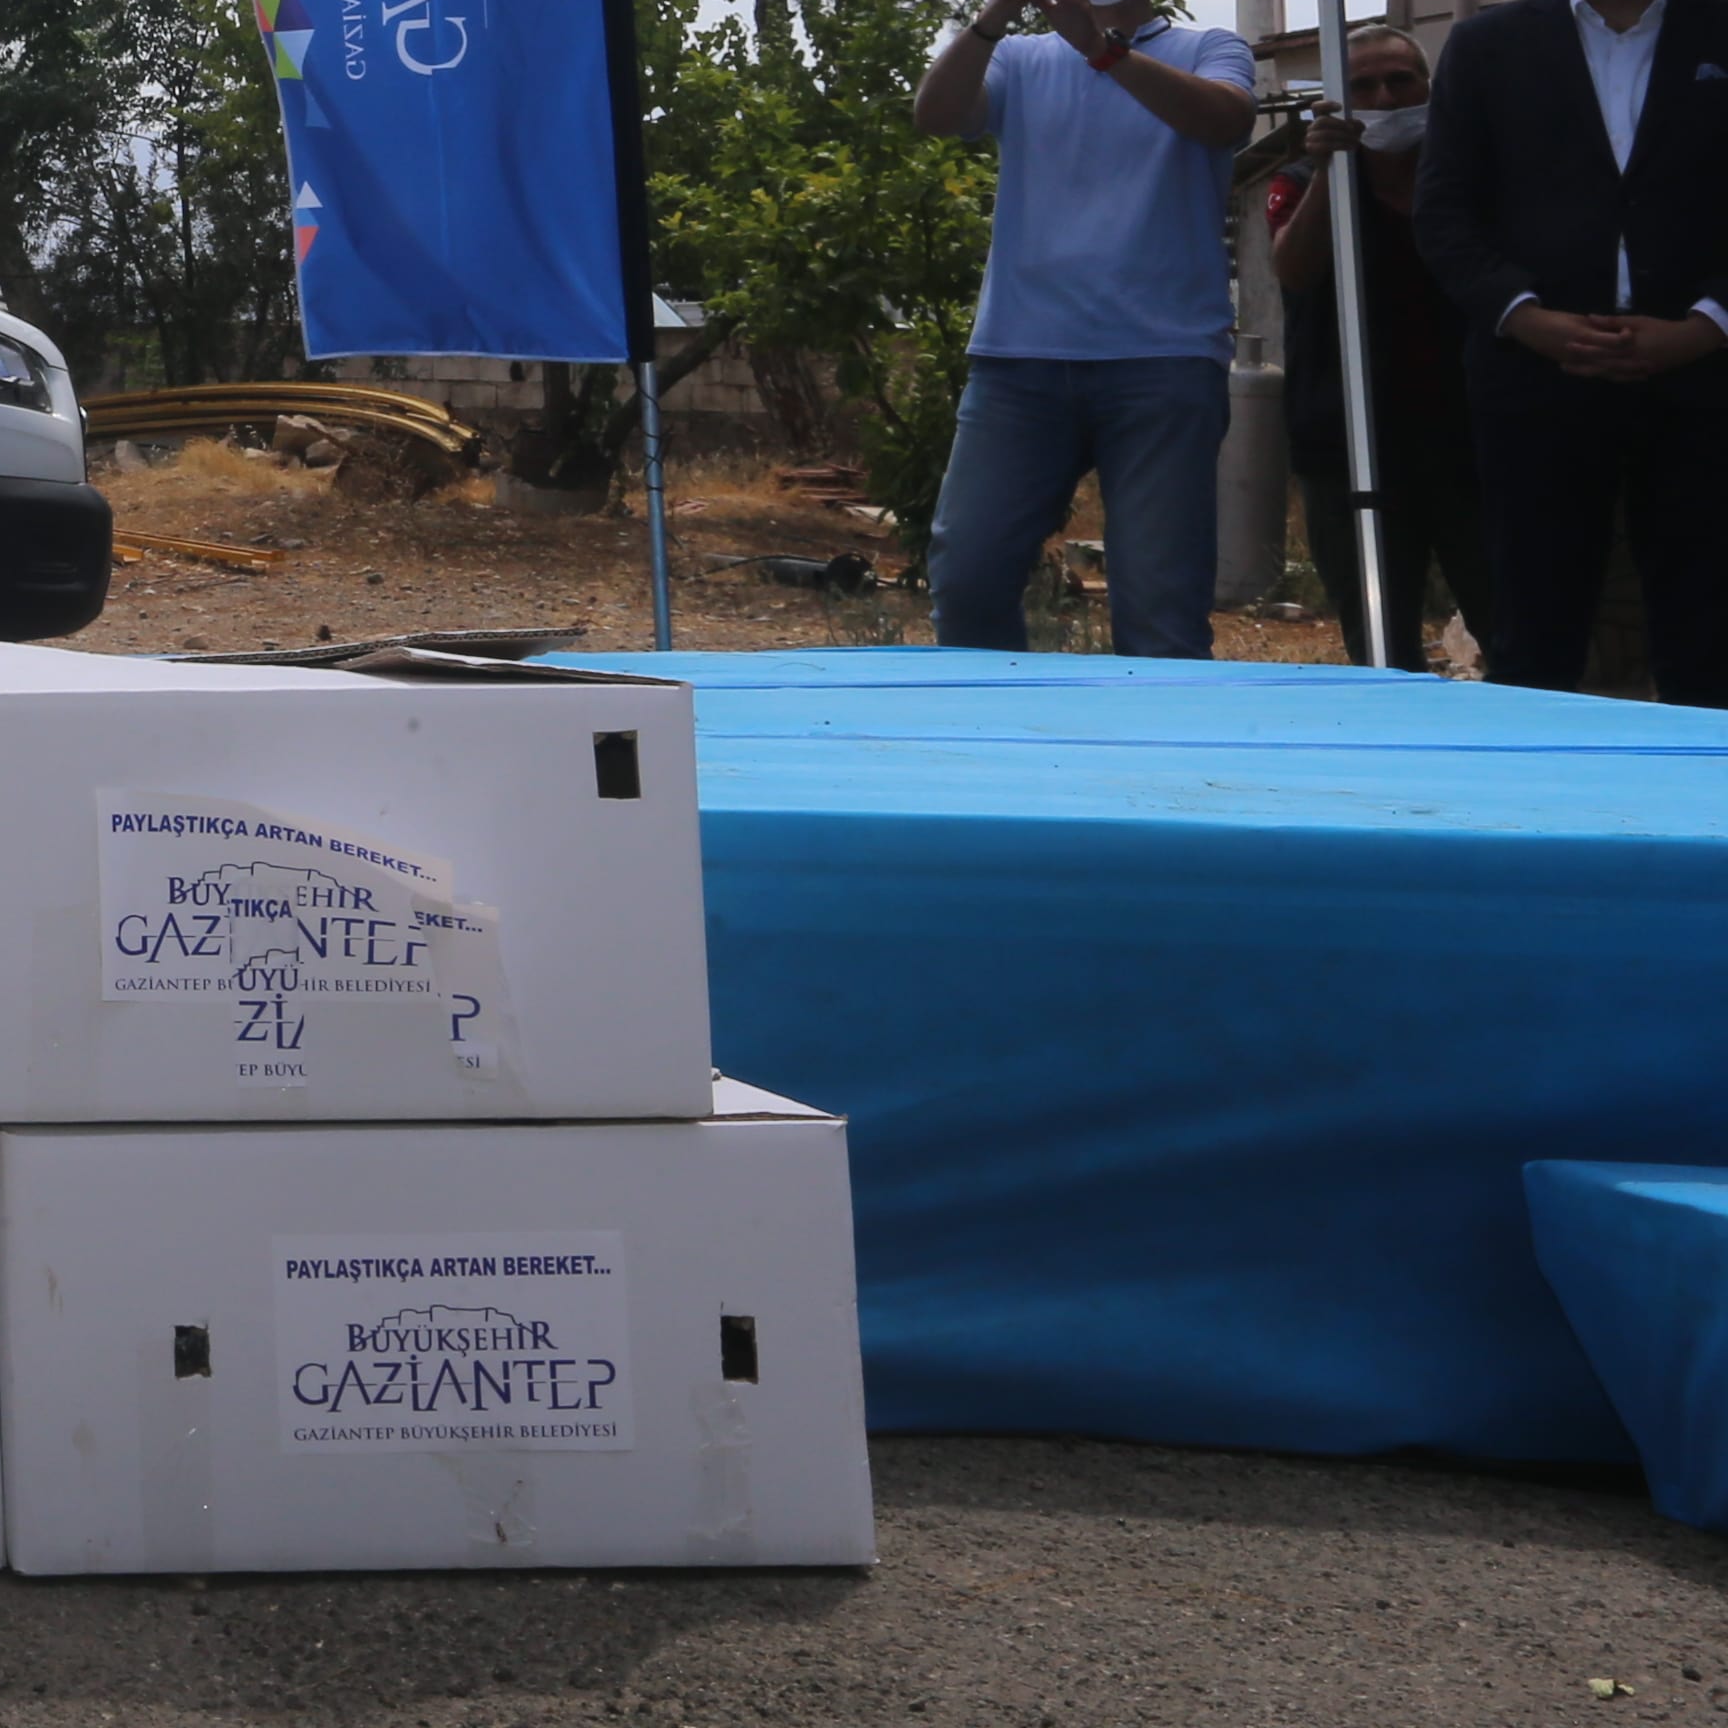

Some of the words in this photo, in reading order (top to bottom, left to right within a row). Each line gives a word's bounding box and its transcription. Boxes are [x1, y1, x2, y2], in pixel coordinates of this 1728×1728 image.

[111, 813, 248, 839] PAYLAŞTIKÇA
[255, 822, 323, 848] ARTAN
[329, 839, 437, 882] BEREKET...
[115, 976, 212, 992] GAZİANTEP
[334, 977, 432, 994] BELEDİYESİ
[286, 1258, 424, 1284] PAYLAŞTIKÇA
[430, 1256, 497, 1277] ARTAN
[503, 1255, 611, 1277] BEREKET...
[345, 1320, 559, 1358] BÜYÜKŞEHİR
[292, 1353, 616, 1413] GAZİANTEP
[293, 1425, 395, 1442] GAZİANTEP
[400, 1423, 514, 1443] BÜYÜKŞEHİR
[520, 1421, 617, 1439] BELEDİYESİ
